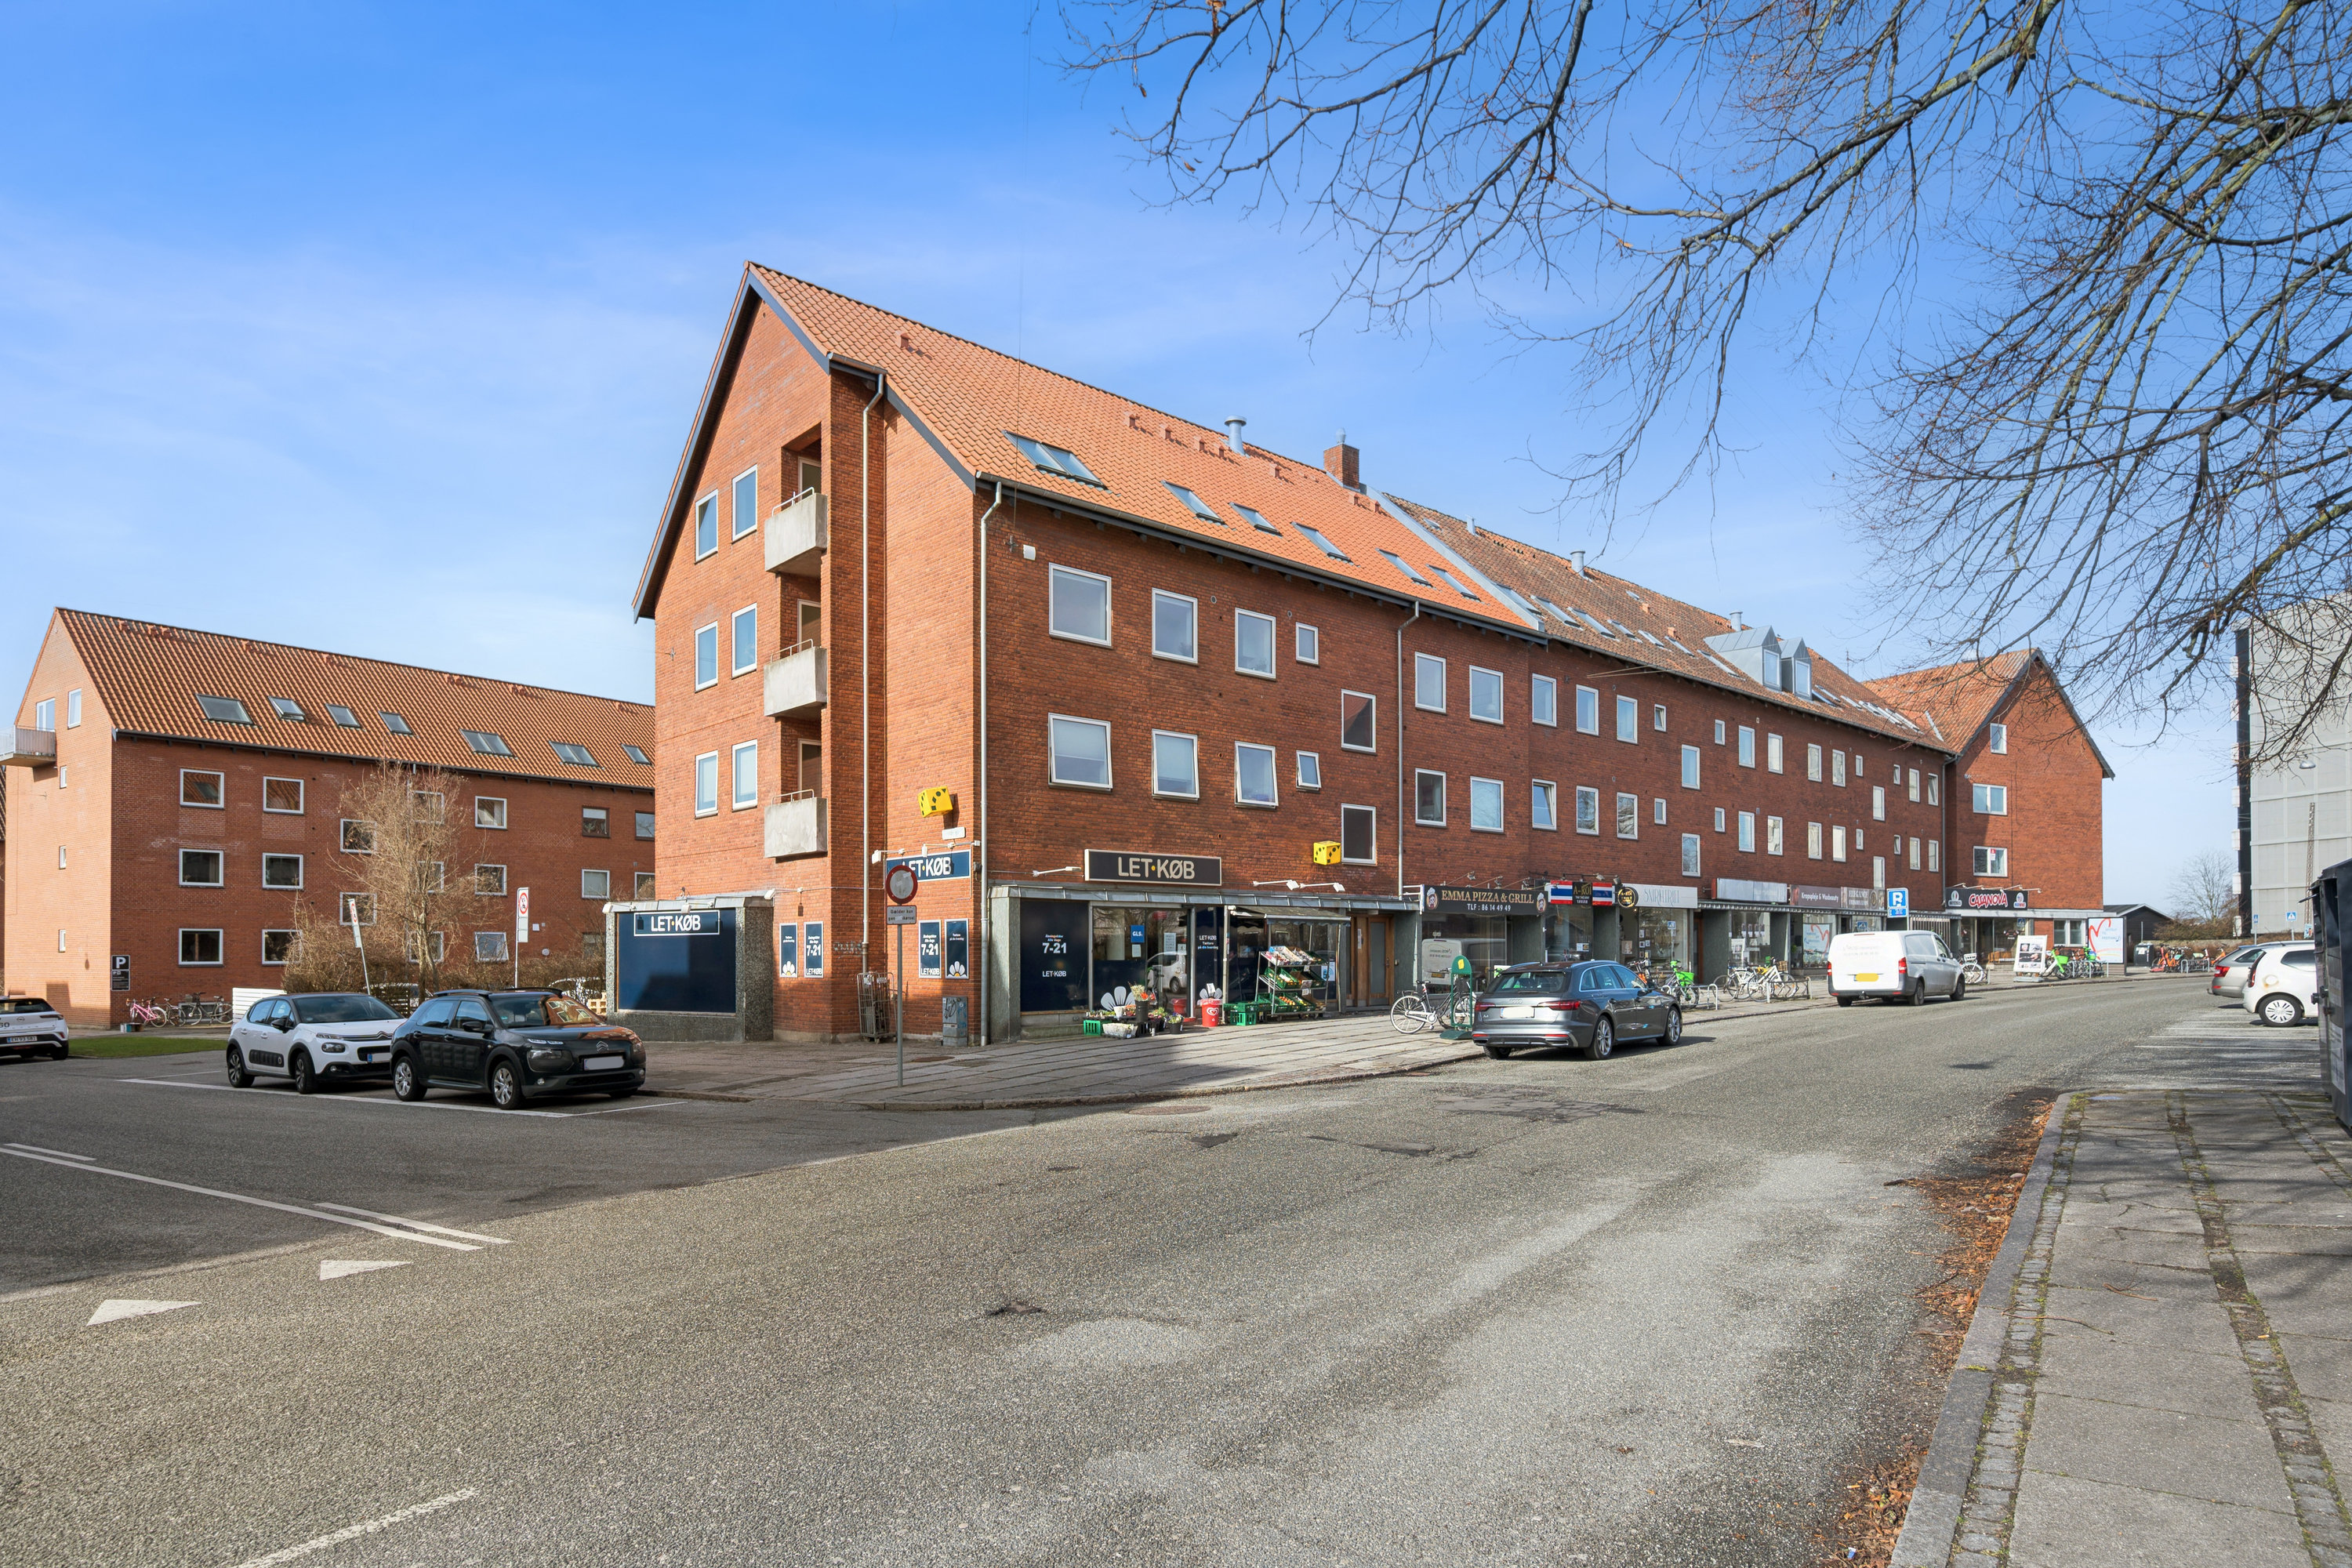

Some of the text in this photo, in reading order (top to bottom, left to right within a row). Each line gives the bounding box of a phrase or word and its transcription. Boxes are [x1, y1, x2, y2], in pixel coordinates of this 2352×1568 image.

[1441, 890, 1534, 904] EMMA PIZZA & GRILL
[1969, 891, 2008, 908] CASANOVA
[806, 944, 822, 956] 7-21
[920, 943, 938, 956] 7-21
[1042, 942, 1067, 953] 7-21
[116, 956, 126, 968] P
